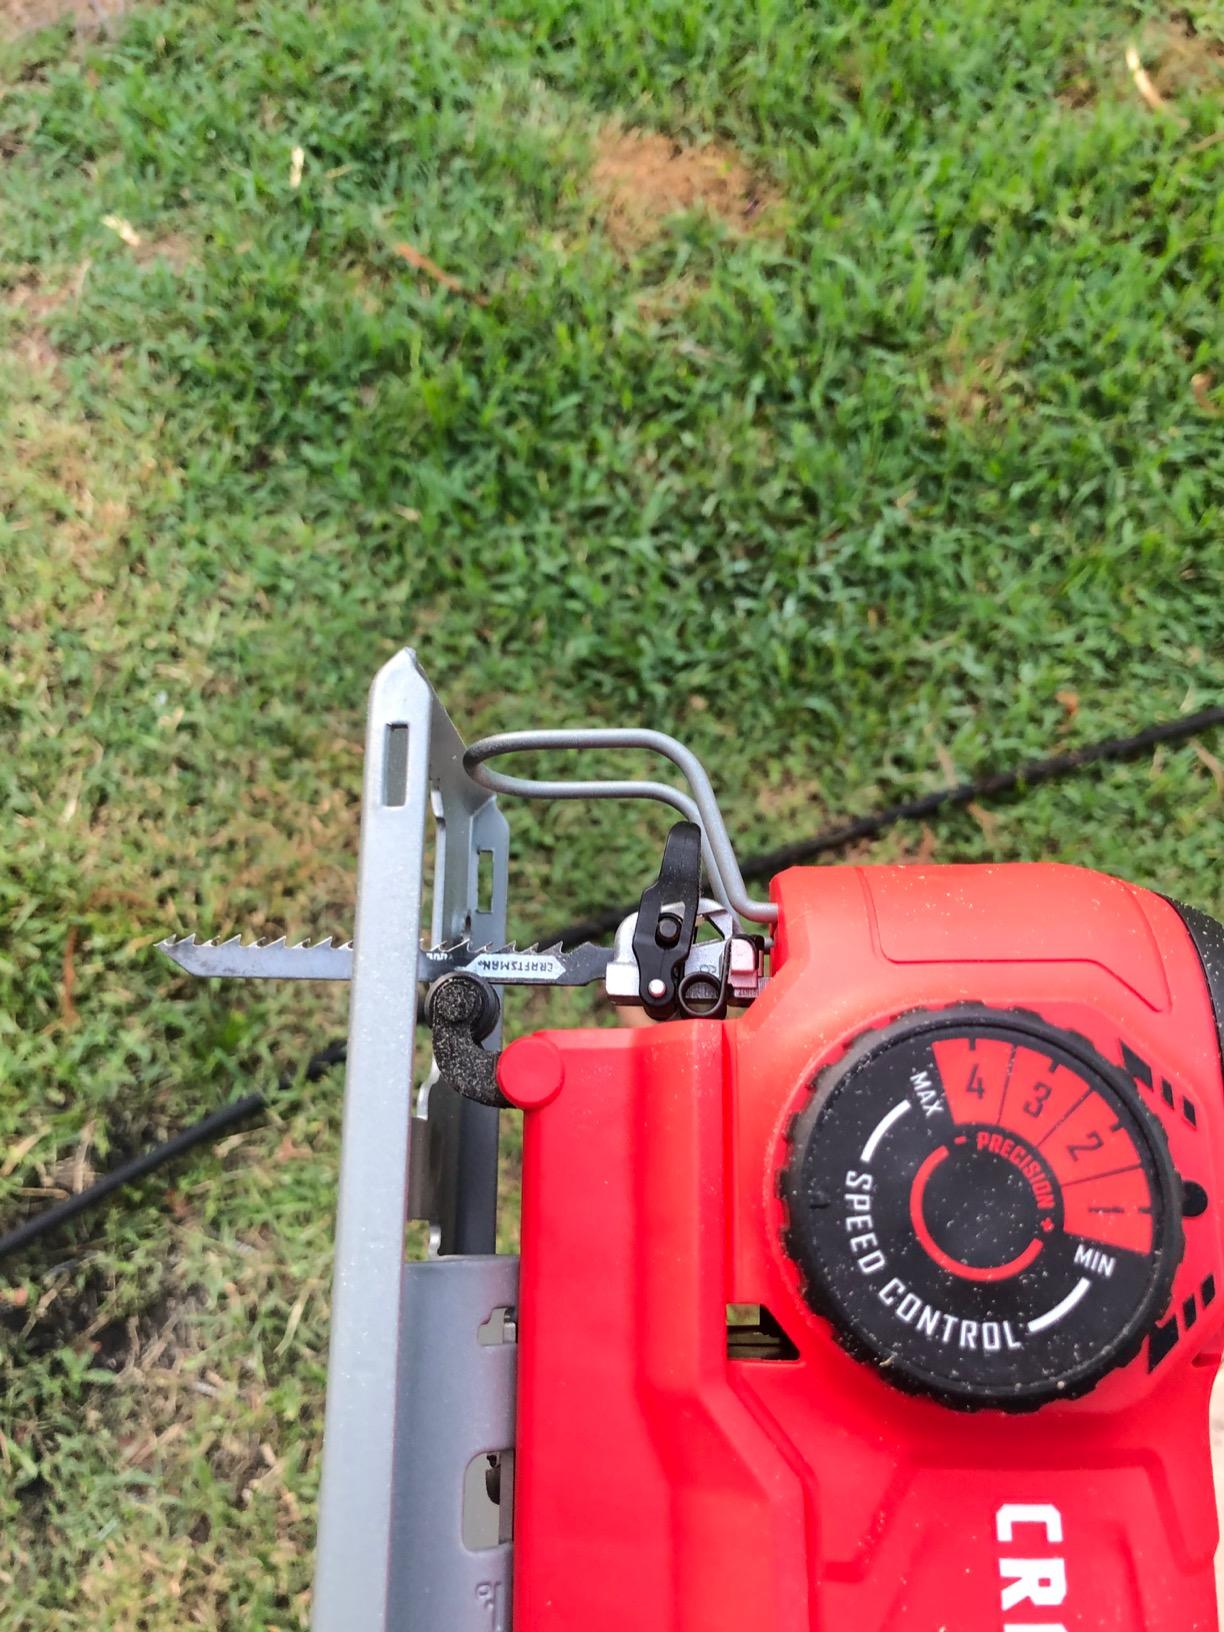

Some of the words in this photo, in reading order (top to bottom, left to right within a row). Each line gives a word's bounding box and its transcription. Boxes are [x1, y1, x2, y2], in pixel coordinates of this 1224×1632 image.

[481, 960, 553, 972] CRAFTSMAN
[910, 1070, 943, 1117] MAX
[965, 1064, 985, 1100] 4
[1025, 1081, 1053, 1118] 3
[1067, 1132, 1103, 1162] 2
[976, 1131, 1056, 1210] PRECISION
[845, 1170, 886, 1276] SPEED
[878, 1277, 1023, 1350] CONTROL
[1074, 1243, 1116, 1279] MIN
[996, 1503, 1068, 1632] CR
